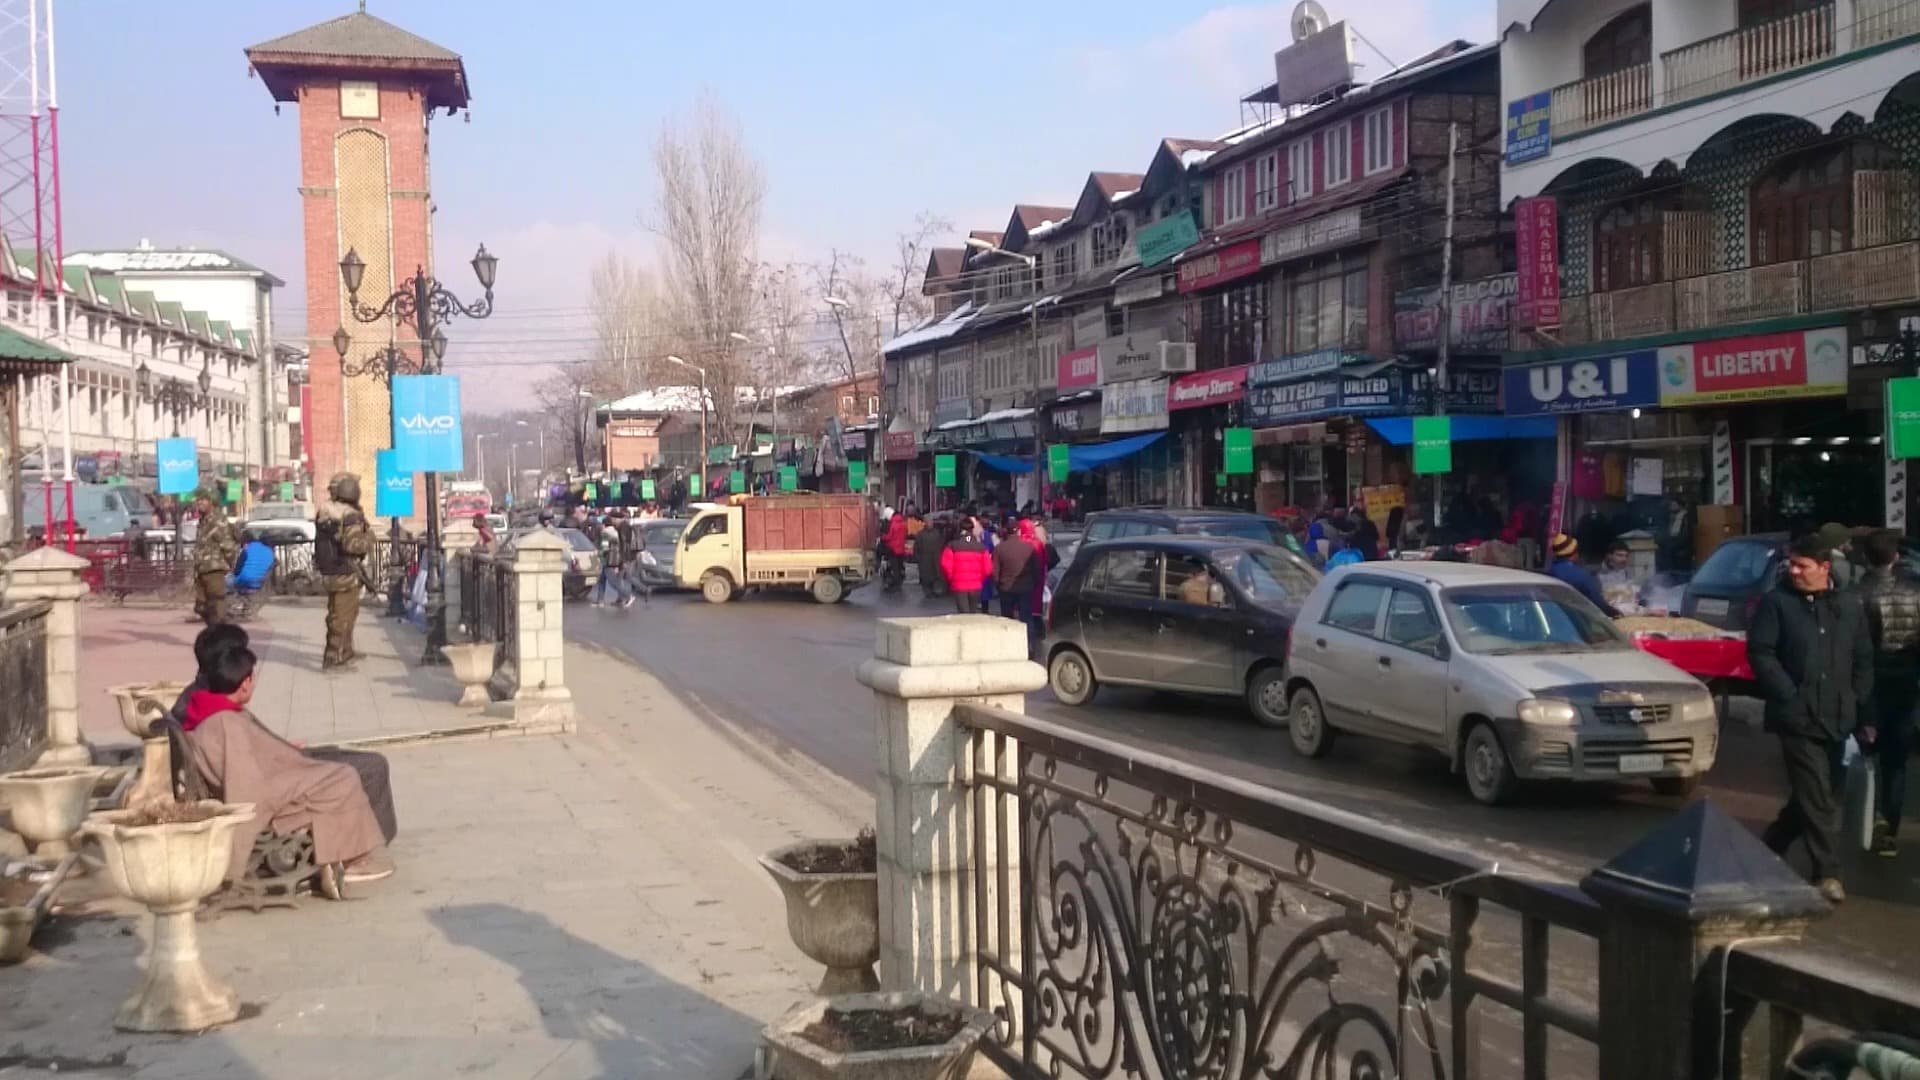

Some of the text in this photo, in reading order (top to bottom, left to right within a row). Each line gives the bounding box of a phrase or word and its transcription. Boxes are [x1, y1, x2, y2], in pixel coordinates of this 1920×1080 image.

[1540, 216, 1554, 297] KASHMIR
[1449, 276, 1518, 302] ELCOM
[1701, 347, 1797, 378] LIBERTY
[1343, 379, 1389, 394] UNITED
[1411, 373, 1497, 393] UITED
[1529, 357, 1629, 402] U&I
[400, 412, 455, 429] vivo
[386, 476, 412, 487] vivo
